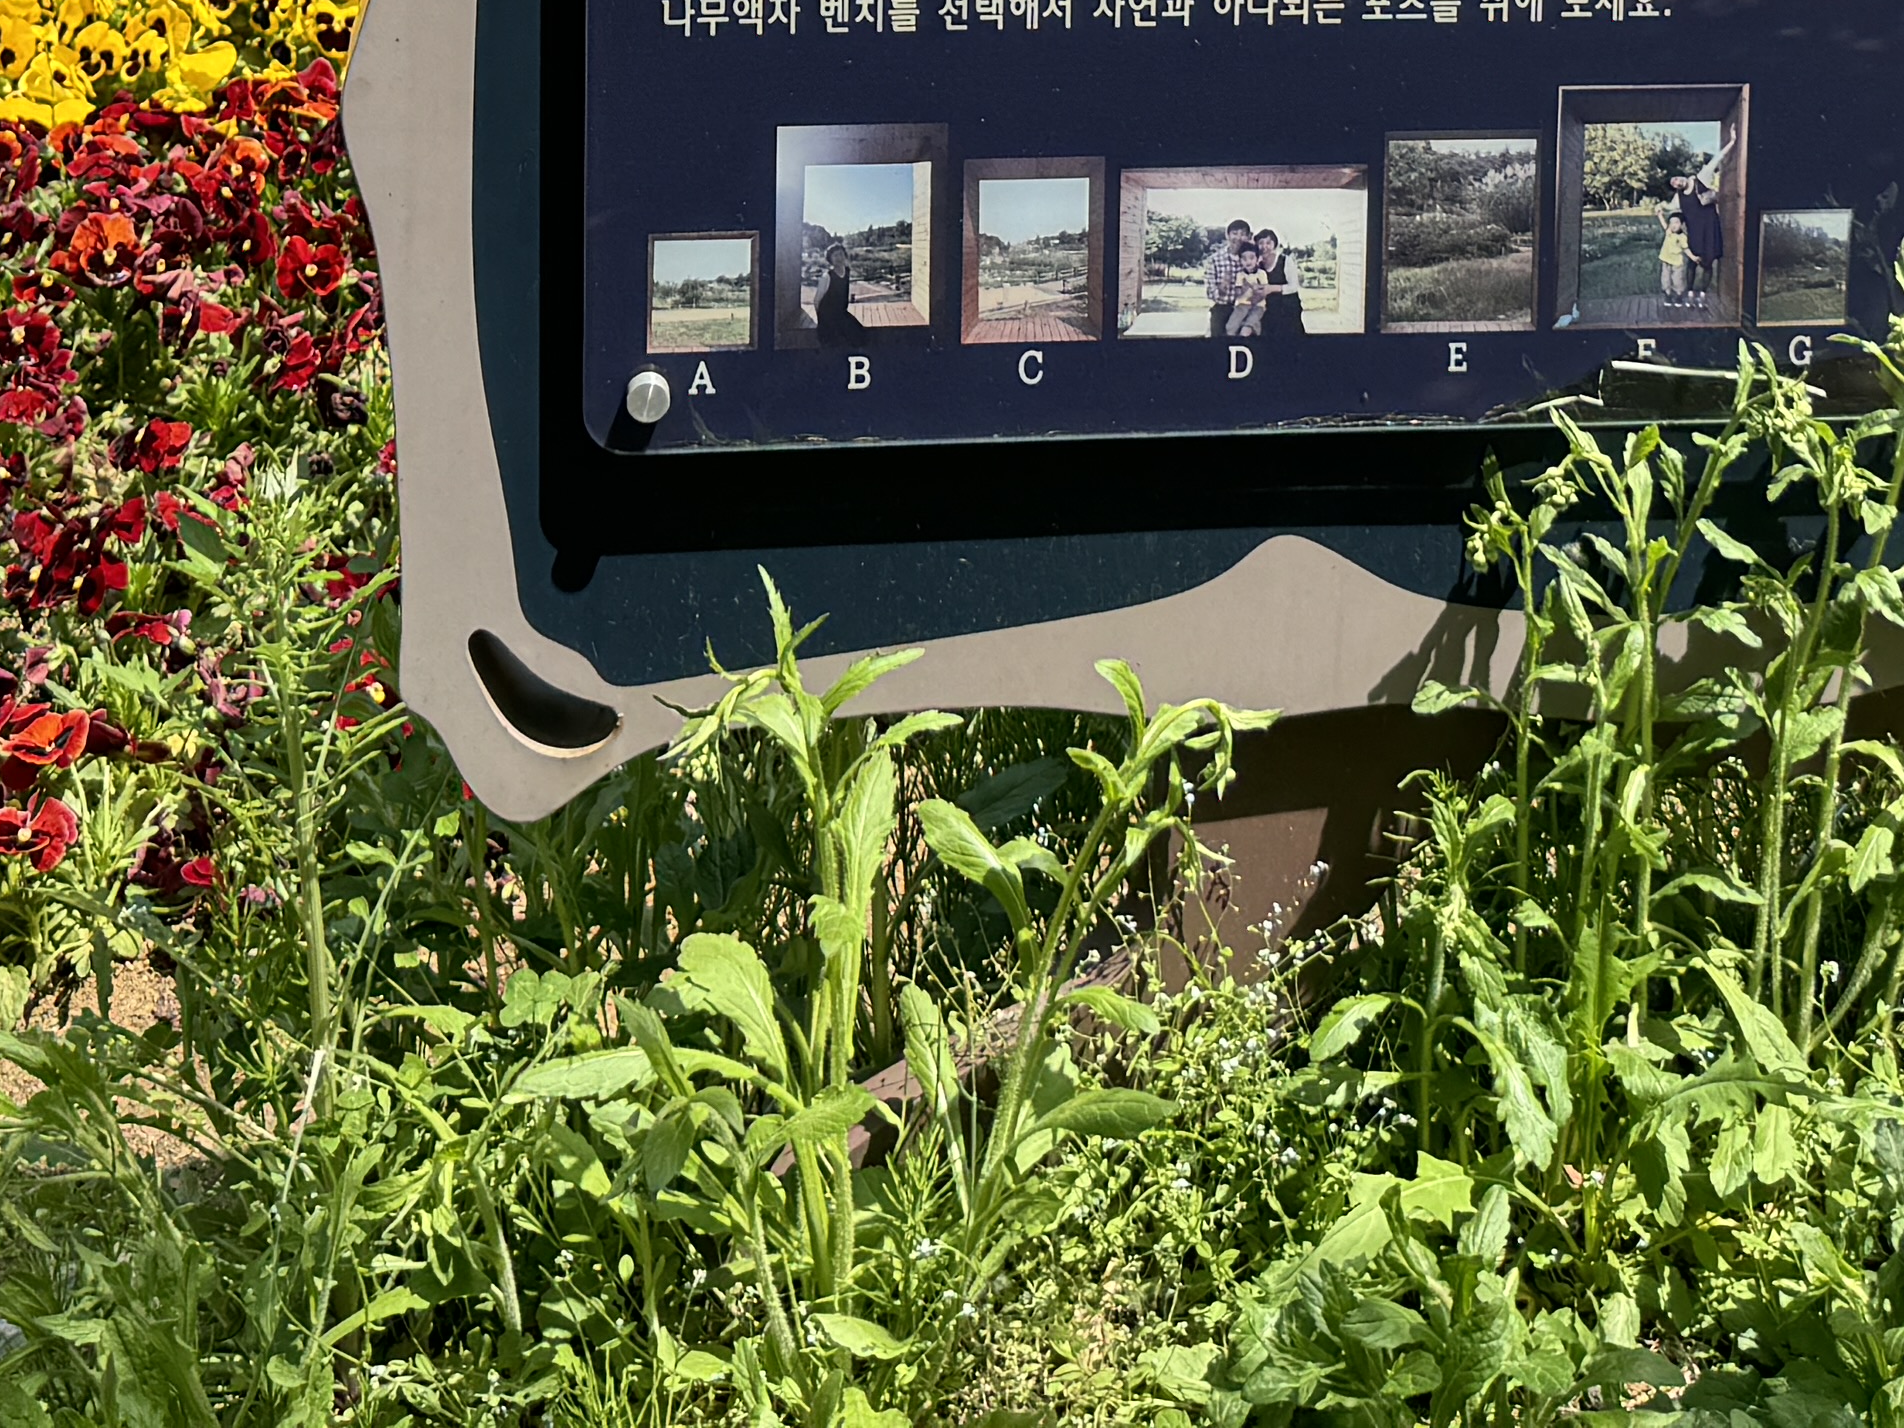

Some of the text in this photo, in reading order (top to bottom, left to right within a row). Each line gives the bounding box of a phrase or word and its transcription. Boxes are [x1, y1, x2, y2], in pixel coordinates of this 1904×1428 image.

[688, 360, 716, 395] A
[847, 356, 871, 390] B
[1018, 349, 1044, 385] C
[1227, 345, 1254, 379] D
[1447, 342, 1468, 373] E
[1788, 335, 1813, 366] G
